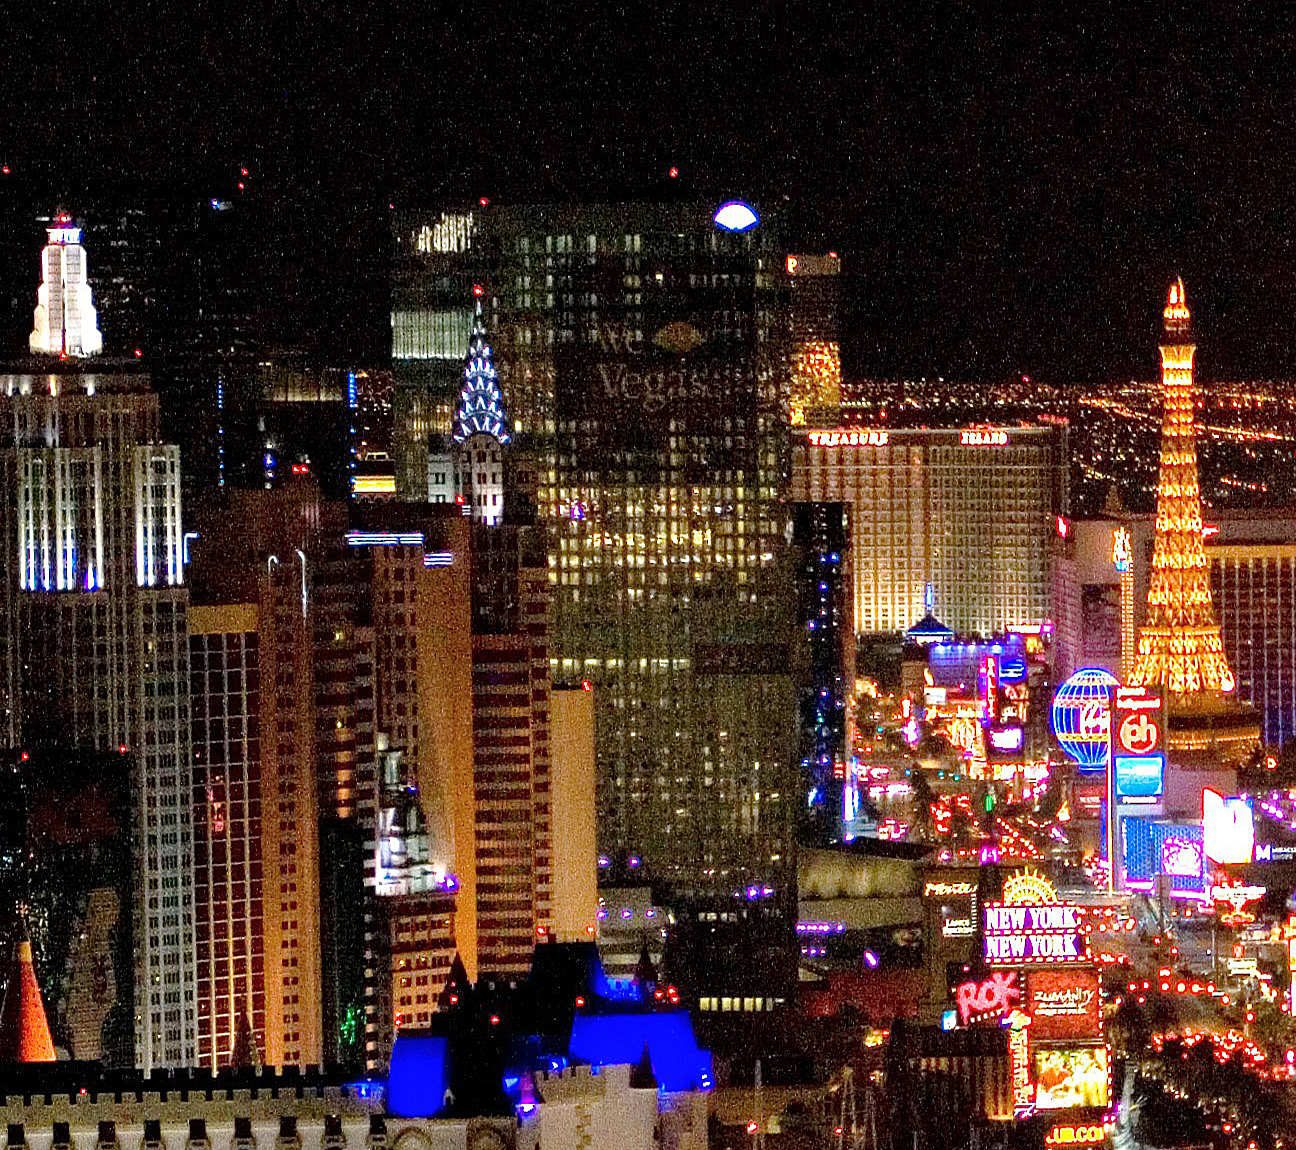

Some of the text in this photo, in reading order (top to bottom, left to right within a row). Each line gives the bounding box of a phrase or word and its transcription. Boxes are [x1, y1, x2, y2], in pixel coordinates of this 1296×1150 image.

[809, 432, 889, 446] TREASURE
[986, 907, 1078, 929] NEW YORK
[986, 935, 1078, 957] NEW YORK
[1033, 987, 1095, 1005] ZUMANITY
